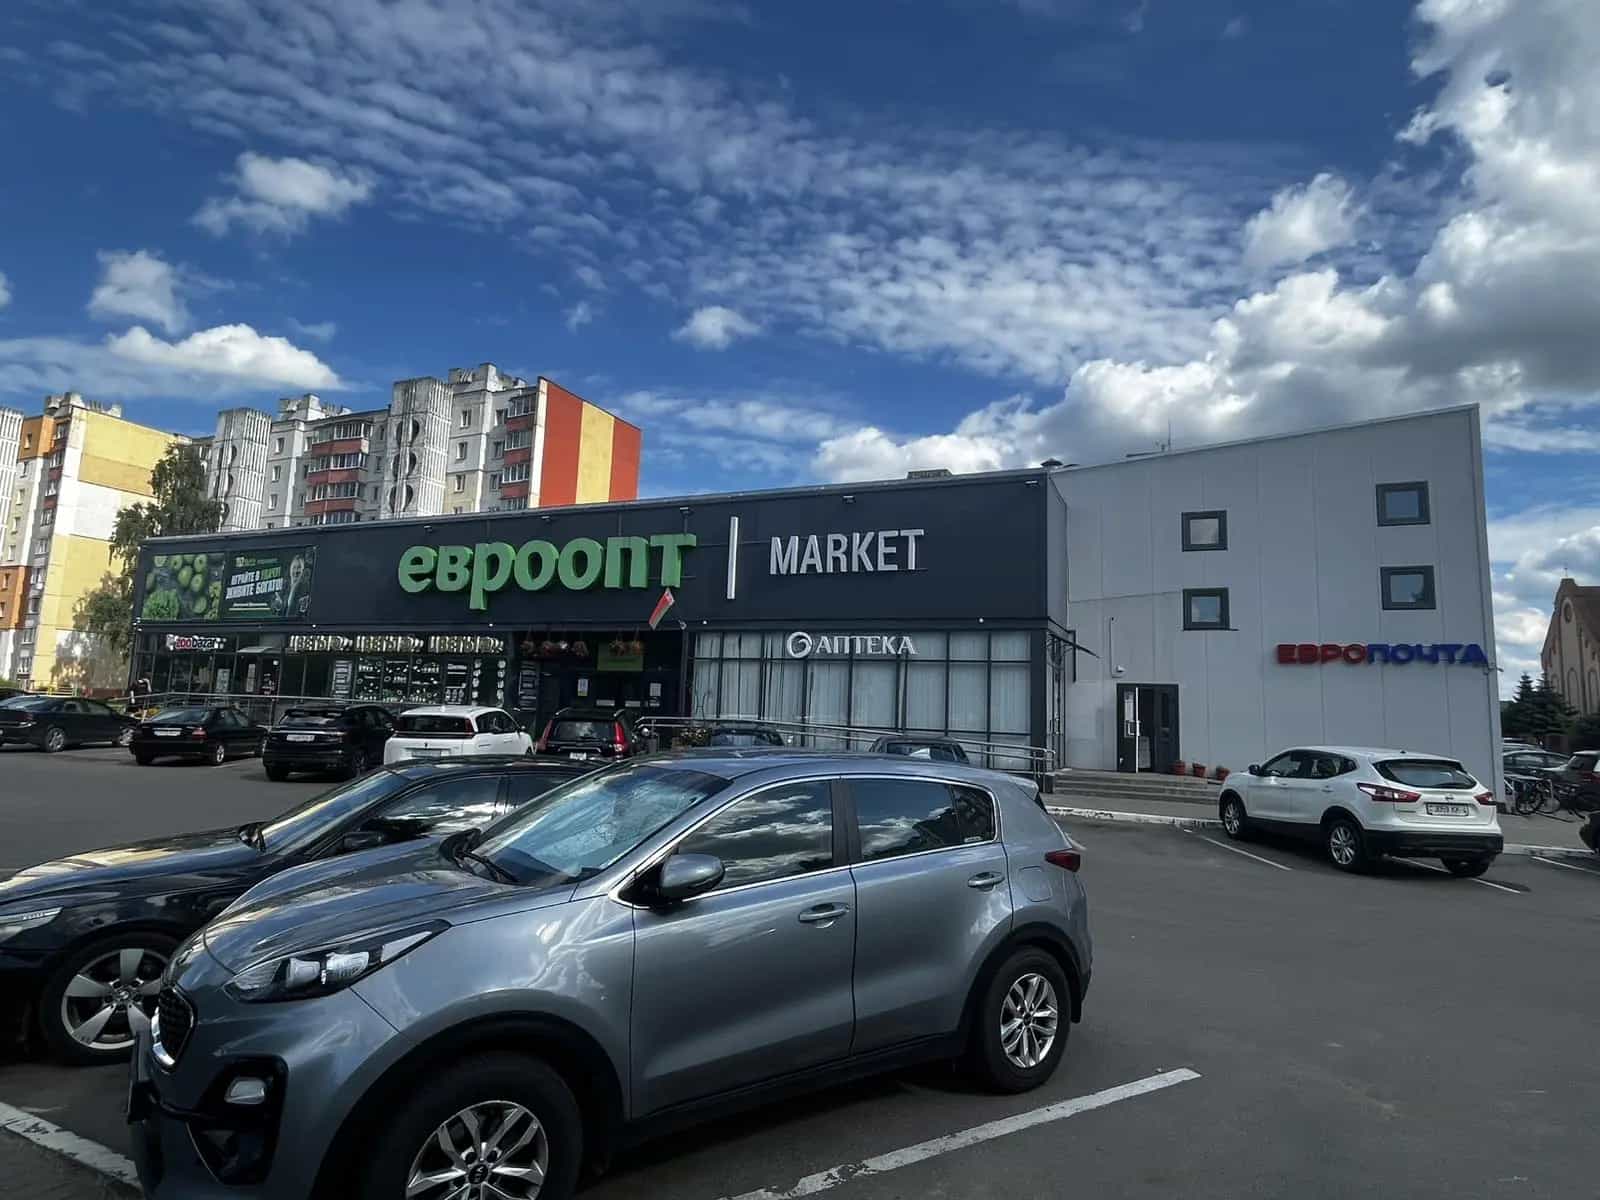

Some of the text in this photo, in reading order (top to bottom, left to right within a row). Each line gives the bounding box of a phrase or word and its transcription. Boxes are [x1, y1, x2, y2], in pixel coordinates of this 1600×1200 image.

[769, 528, 924, 575] MARKET
[398, 533, 697, 610] евроопт
[815, 635, 918, 655] АПТЕКА
[1276, 643, 1489, 666] ЕВРОПОЧТА
